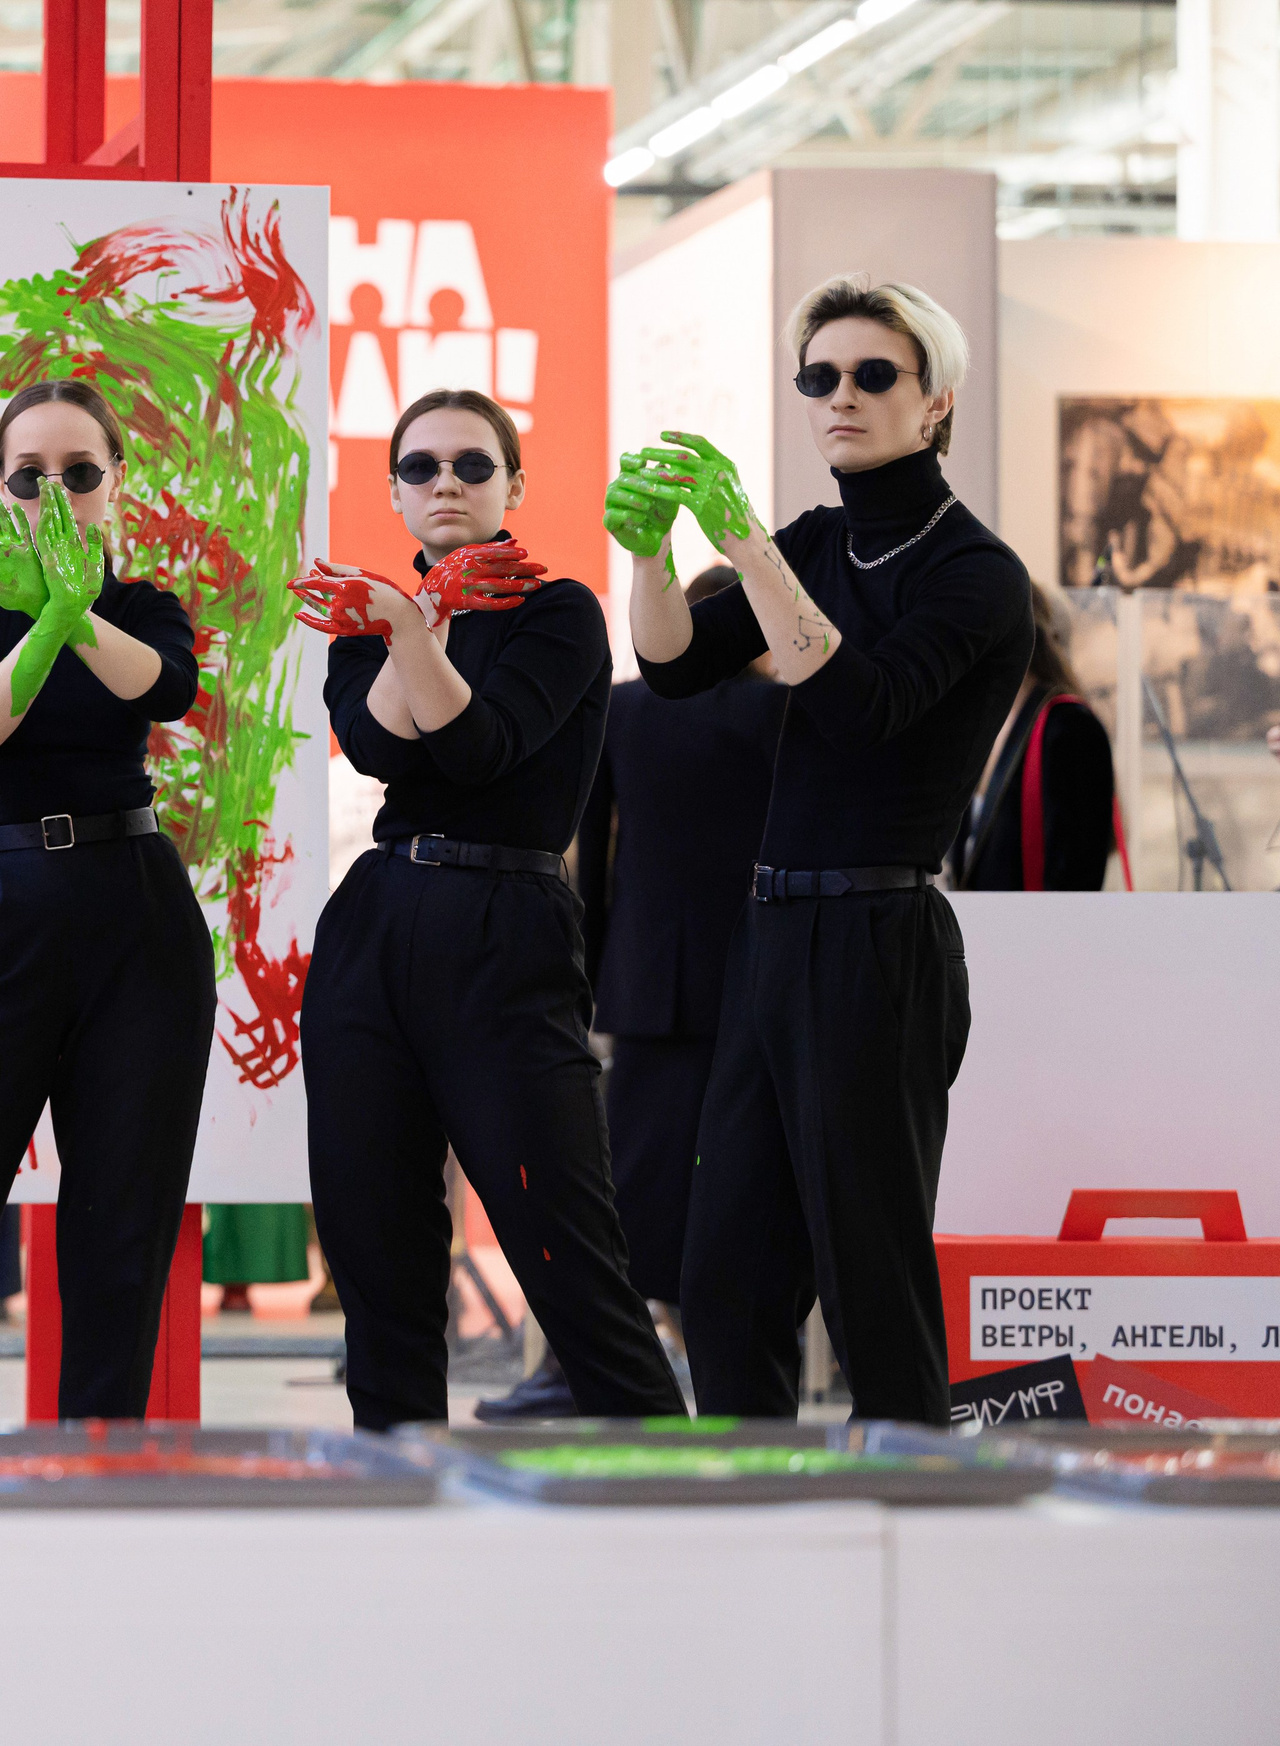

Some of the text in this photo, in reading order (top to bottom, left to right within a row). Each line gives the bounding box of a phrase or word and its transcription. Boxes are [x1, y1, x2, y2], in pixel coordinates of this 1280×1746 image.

[981, 1287, 1092, 1311] ПРОЕКТ
[981, 1324, 1087, 1353] ВЕТРЫ,
[1111, 1324, 1237, 1354] АНГЕЛЫ,
